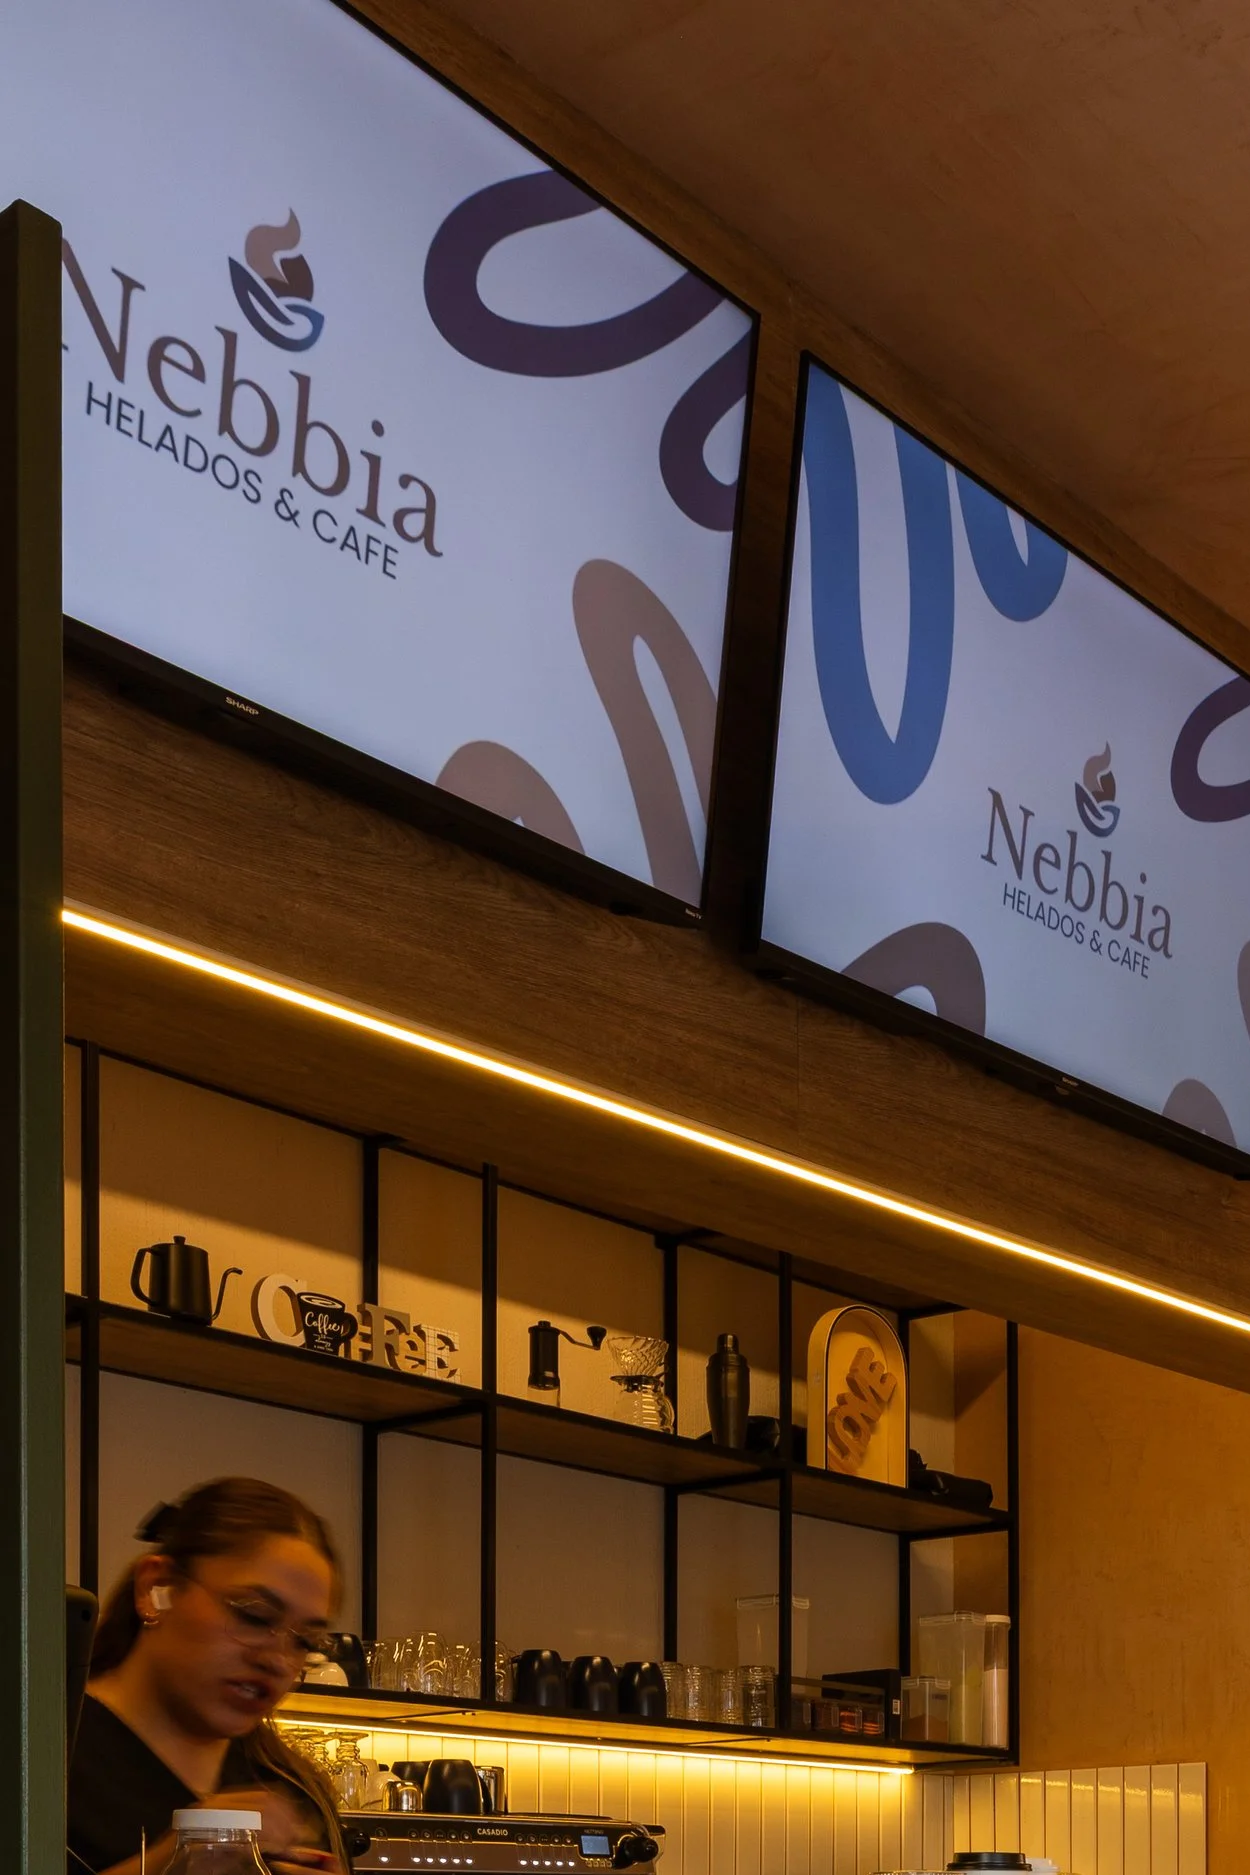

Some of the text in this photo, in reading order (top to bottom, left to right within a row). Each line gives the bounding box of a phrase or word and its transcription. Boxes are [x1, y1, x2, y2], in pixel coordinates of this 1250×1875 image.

[62, 238, 443, 558] Nebbia
[85, 381, 399, 580] HELADOS & CAFE
[980, 787, 1172, 959] Nebbia
[1002, 882, 1150, 979] HELADOS & CAFE
[477, 1827, 509, 1837] CASADIO
